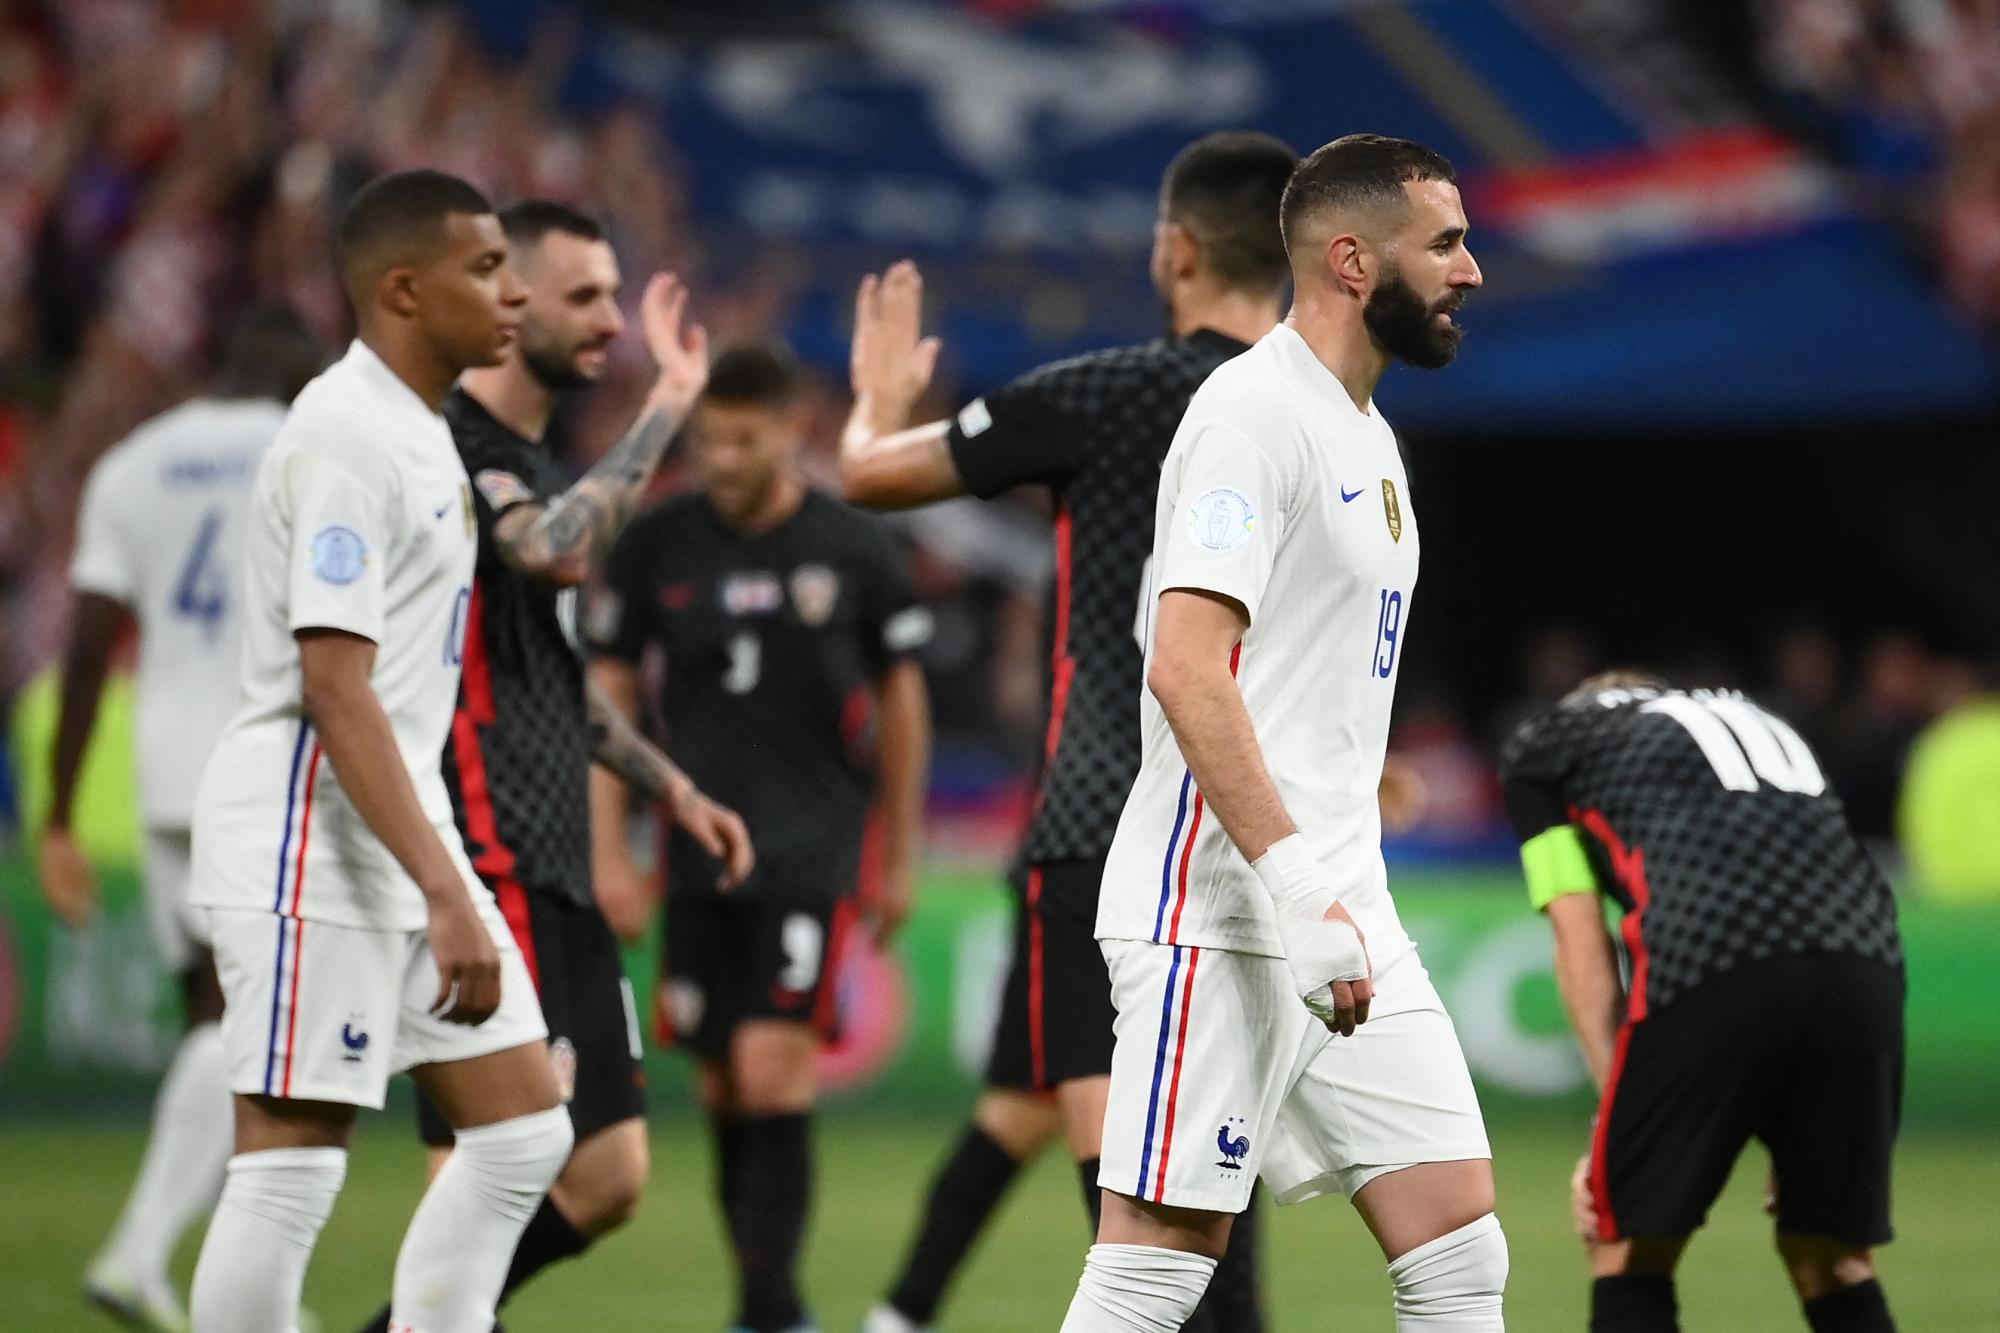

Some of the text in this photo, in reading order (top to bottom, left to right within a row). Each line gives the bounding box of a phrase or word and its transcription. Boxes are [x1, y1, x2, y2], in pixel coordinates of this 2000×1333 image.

[174, 508, 226, 637] 4
[1371, 588, 1402, 679] 19
[1638, 694, 1826, 798] 10
[779, 911, 823, 992] 9
